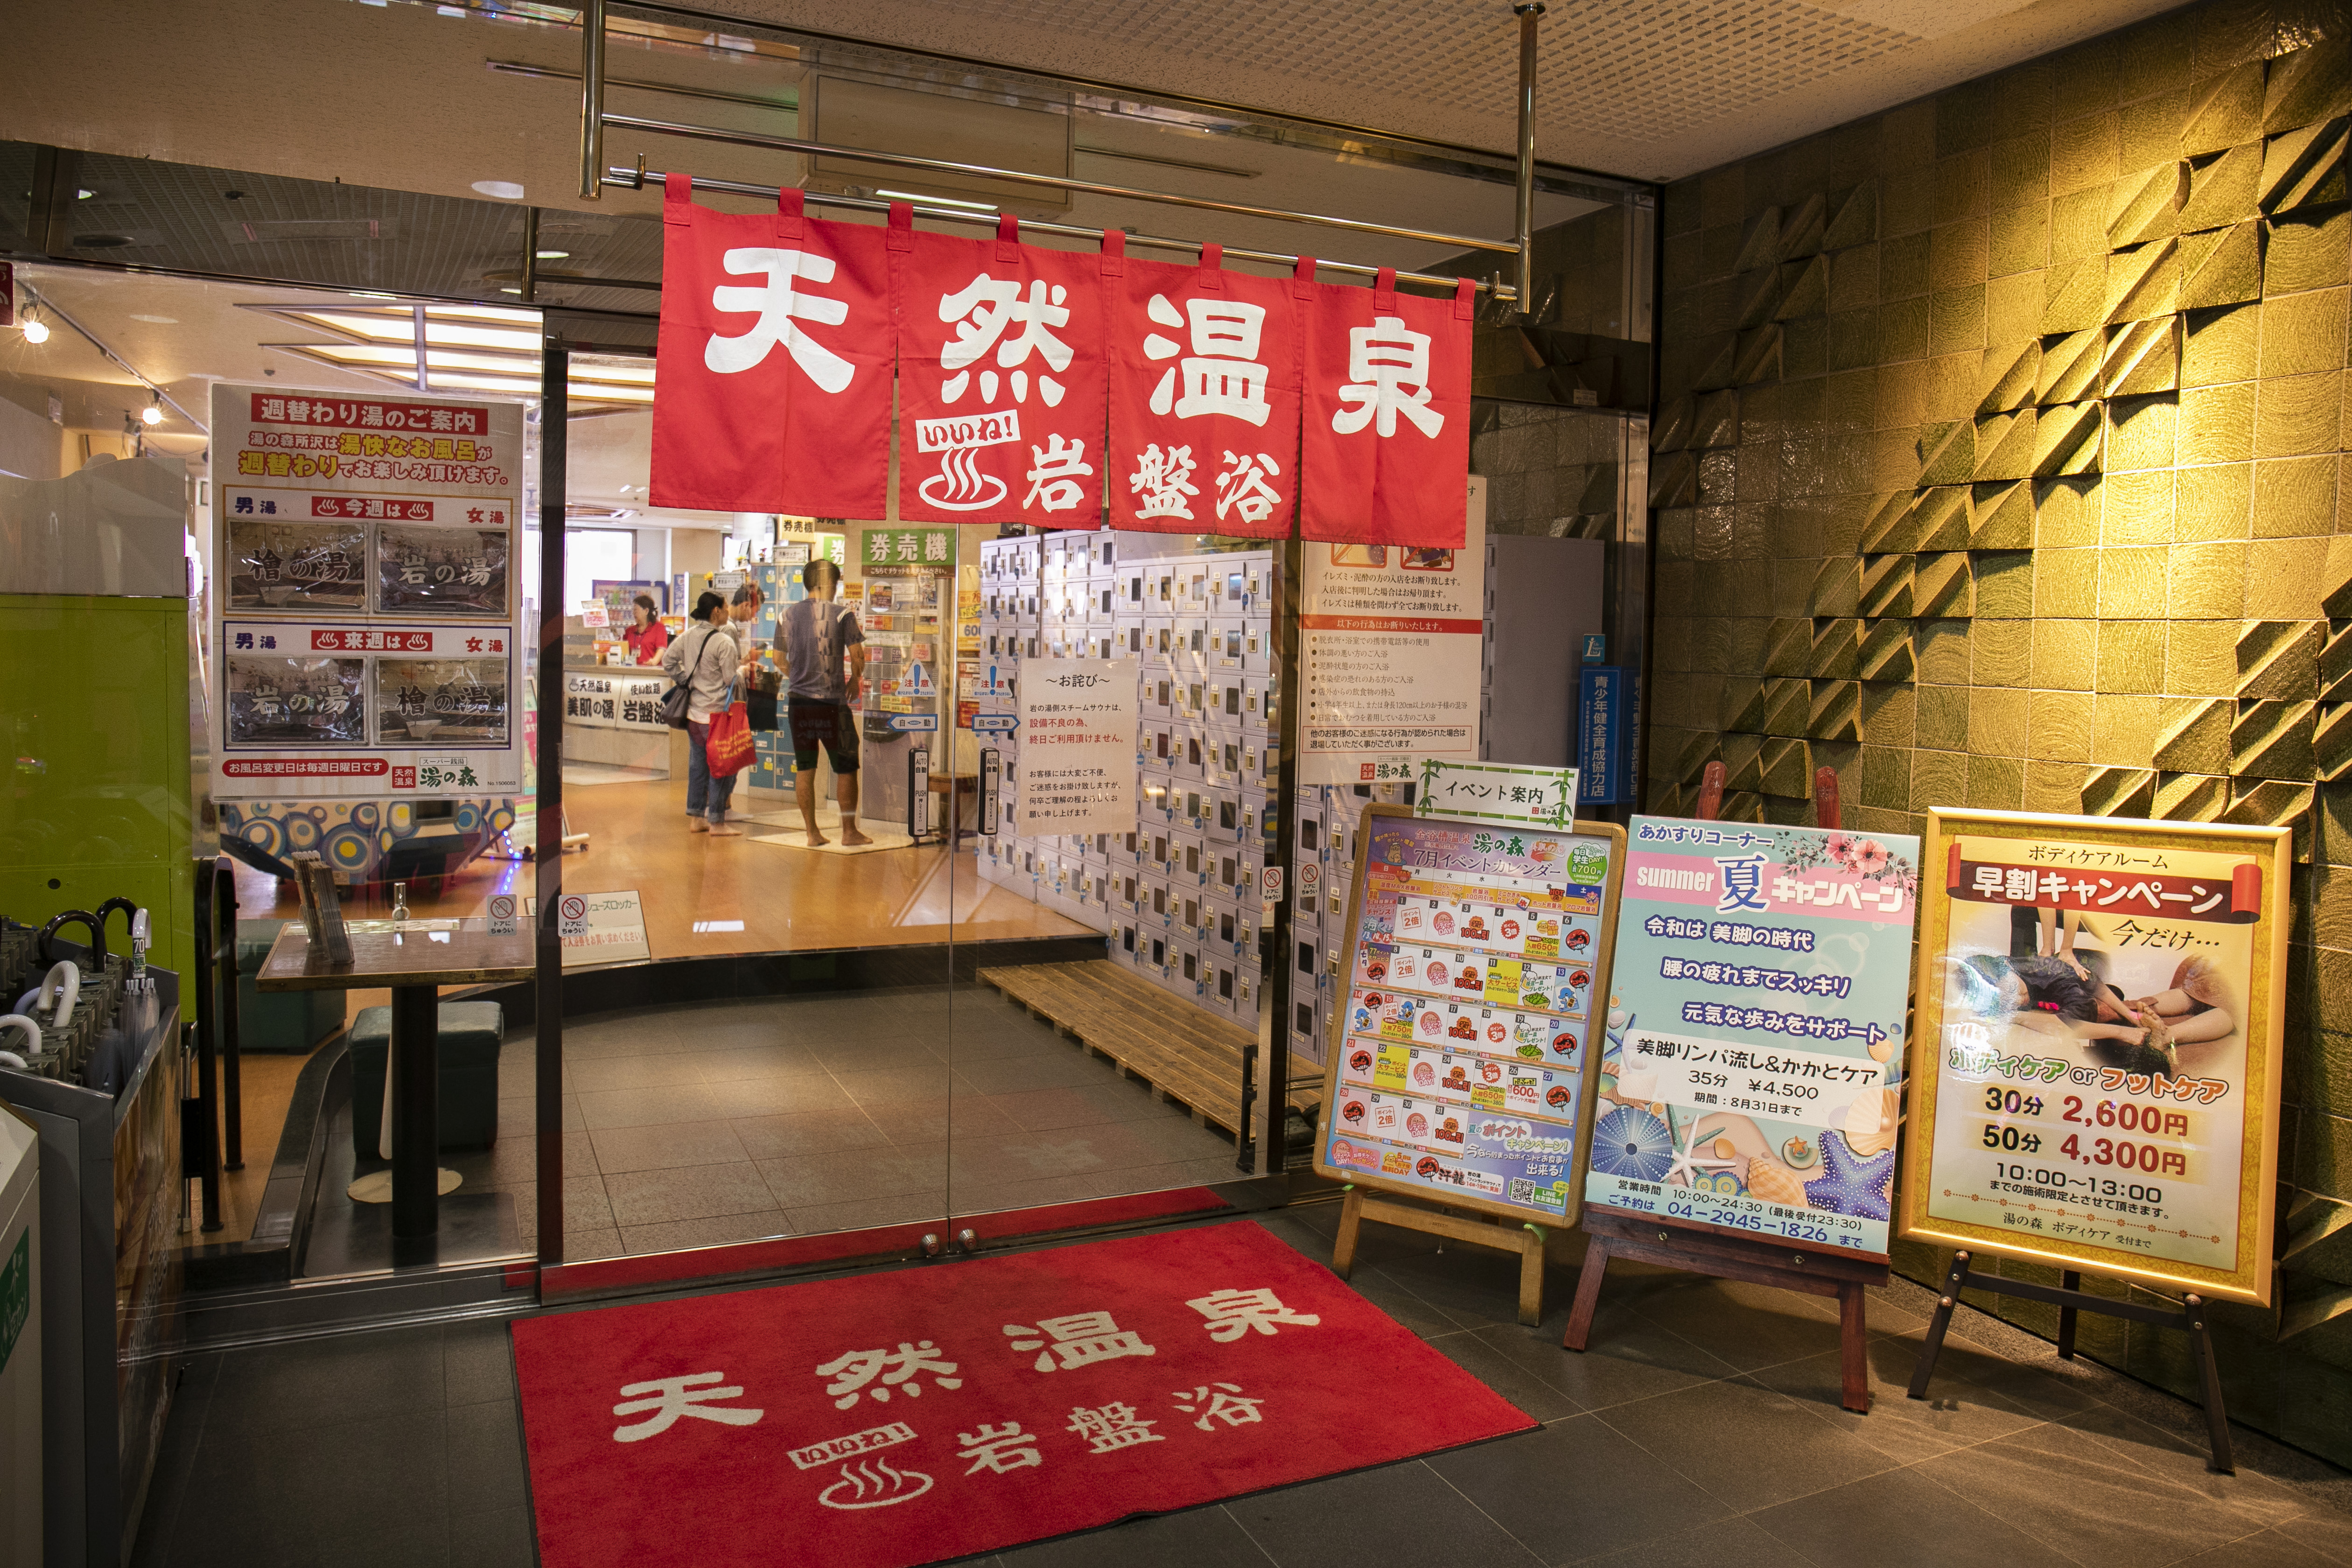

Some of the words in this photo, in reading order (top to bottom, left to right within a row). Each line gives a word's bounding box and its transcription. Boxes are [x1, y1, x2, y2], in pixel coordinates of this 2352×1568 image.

[704, 246, 1445, 439] 天然温泉
[261, 399, 476, 433] 週替わり湯のご案内
[250, 432, 492, 462] 湯の森所沢は湯快なお風呂が
[238, 452, 509, 485] 週替わりでお楽しみ頂けます。
[1023, 432, 1282, 524] 岩盤浴
[235, 497, 276, 514] 男湯
[346, 499, 401, 518] 今週は
[467, 508, 504, 525] 女湯
[870, 533, 947, 561] 券売機
[249, 548, 350, 582] 檜の湯
[399, 555, 492, 586] 岩の湯
[1323, 572, 1460, 586] イレズミ・泥酔の方の入店をお断り致します。
[1322, 599, 1462, 612] イレズミは種類を問わず全てお断り致します。
[1337, 619, 1442, 631] 以下の行為はお断りいたします。
[235, 633, 276, 649] 男湯
[345, 632, 400, 649] 来週は
[466, 637, 504, 653] 女湯
[1319, 649, 1388, 658] 体調の悪い方のご入浴
[1318, 662, 1389, 671] 泥酔状態の方のご入浴
[579, 679, 612, 693] 天然温泉
[630, 682, 661, 696] 使い放題
[1318, 675, 1414, 684] 感染症の恐れのある方のご入浴
[250, 685, 349, 715] 岩の湯
[397, 686, 491, 716] 檜の湯
[1318, 688, 1395, 696] 店外からの飲食物の持込
[568, 698, 615, 720] 美肌の湯
[1029, 704, 1122, 712] 岩の湯側スチームサウナは、
[1029, 718, 1088, 728] 設備不良の為、
[1310, 729, 1465, 737] 他のお客様のご迷惑になる行為が認められた場合は
[1029, 734, 1124, 744] 終日ご利用頂けません。
[1310, 740, 1414, 749] 退場していただく事がございます。
[1591, 676, 1608, 797] 青少年健全育成協力店
[229, 762, 382, 774] お風呂変更日は毎週日曜日です
[395, 768, 413, 777] 天然
[420, 766, 478, 788] 湯の森
[1029, 769, 1107, 777] お客様には大変ご不便、
[1377, 763, 1411, 779] 湯の森
[395, 777, 413, 786] 温泉
[1029, 782, 1121, 791] ご迷惑をお掛け致しますが、
[1446, 781, 1543, 804] イベント案内
[1029, 795, 1118, 805] 何卒ご理解の程よろしくお
[1029, 809, 1092, 818] 願い申し上げます。
[1415, 829, 1470, 844] 全浴槽温泉
[1473, 833, 1525, 858] 湯の森
[1639, 825, 1773, 848] あかすりコーナー
[1414, 849, 1560, 876] 7月イベントカレンダー
[2029, 846, 2168, 869] ボディケアルーム
[1637, 865, 1715, 892] summer
[1717, 855, 1769, 911] 夏
[1772, 877, 1903, 912] キャンペーン
[1973, 867, 2223, 913] 早割キャンペーン
[1404, 917, 1419, 926] 2倍
[1435, 920, 1455, 929] レディース
[1505, 928, 1517, 937] 3倍
[1647, 917, 1705, 938] 令和は
[1713, 924, 1813, 950] 美脚の時代
[134, 939, 144, 953] 70
[1663, 959, 1849, 996] 腰の疲れまでスッキリ
[1684, 1004, 1885, 1044] 元気な歩みをサポート
[1637, 1038, 1877, 1085] 美脚リンパ流し&かかとケア
[1513, 1086, 1539, 1098] 600円
[1689, 1071, 1728, 1088] 35分
[1749, 1078, 1818, 1099] ¥4,500
[2072, 1068, 2097, 1085] or
[2101, 1066, 2228, 1104] フットケア
[1986, 1087, 2044, 1116] 30分
[2063, 1096, 2188, 1136] 2,600円
[1468, 1125, 1481, 1134] 夏の
[1483, 1126, 1526, 1137] ポイント
[1508, 1139, 1568, 1151] キャンペーン!
[1983, 1124, 2042, 1153] 50分
[2061, 1134, 2185, 1176] 4,300円
[1526, 1163, 1563, 1176] 出来る!
[1618, 1180, 1661, 1196] 営業時間
[1990, 1180, 2170, 1220] までの施術限定とさせて頂きます。
[1609, 1195, 1654, 1210] ご予約は
[1839, 1234, 1862, 1247] まで
[2004, 1212, 2042, 1230] 湯の森
[2053, 1222, 2111, 1240] ボディケア
[2116, 1234, 2151, 1248] 受付まで
[612, 1287, 1320, 1443] 天然温泉
[957, 1382, 1265, 1476] 岩盤浴
